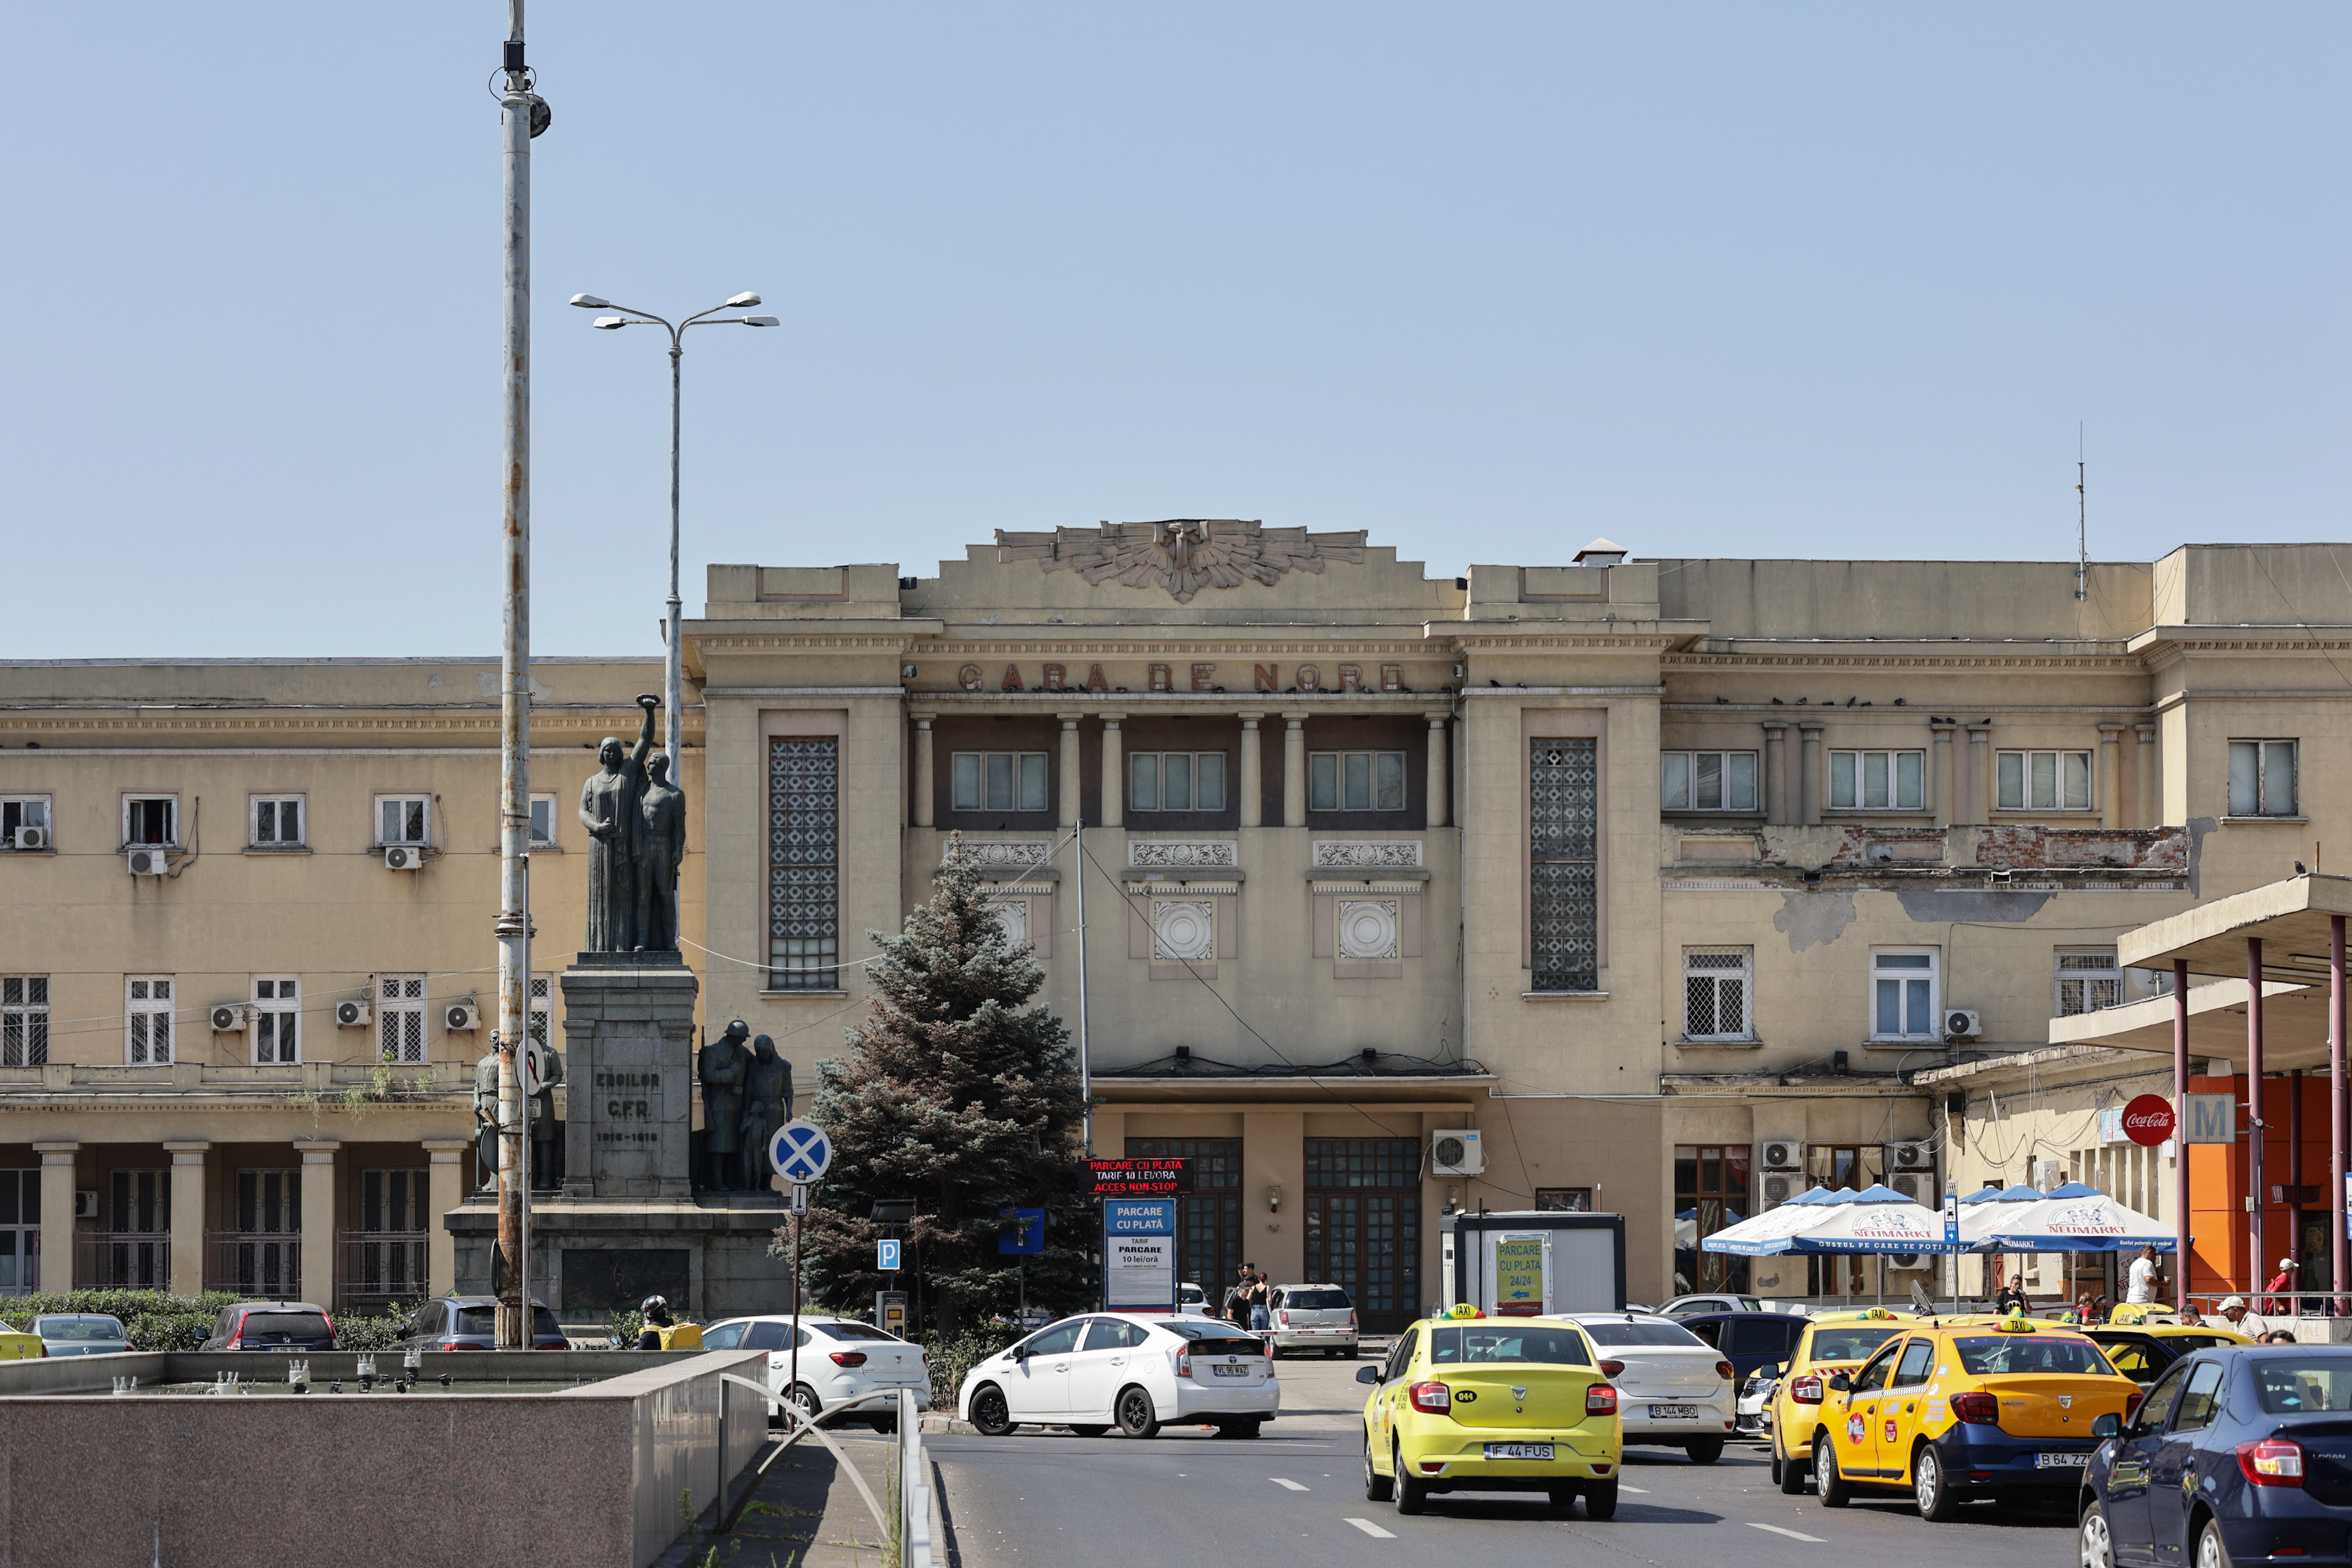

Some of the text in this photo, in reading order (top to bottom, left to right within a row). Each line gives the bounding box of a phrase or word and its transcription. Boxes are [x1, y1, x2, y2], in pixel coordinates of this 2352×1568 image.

[959, 664, 1405, 690] GARA DE NORD
[596, 1073, 659, 1087] EROILOR
[608, 1100, 651, 1117] C.F.R.
[2126, 1112, 2171, 1129] Coca-Cola
[2195, 1101, 2226, 1137] M
[1090, 1160, 1183, 1170] PARCARE CU PLATA
[1096, 1170, 1176, 1180] TARIF 10 LEI/ORA
[1094, 1182, 1177, 1192] ACCES NON-STOP
[1117, 1207, 1163, 1216] PARCARE
[1116, 1218, 1164, 1229] CU PLATĂ
[1946, 1222, 1956, 1231] TAXI
[2046, 1222, 2127, 1234] NEUMARKT
[1851, 1227, 1932, 1238] NEUMARKT
[2001, 1236, 2035, 1248] NEUMARKT
[1499, 1245, 1541, 1256] PARCARE
[1133, 1255, 1158, 1263] lei/oră
[1499, 1260, 1541, 1271] CU PLATA
[1510, 1276, 1532, 1286] 24/24
[1455, 1306, 1471, 1316] TAXI
[1871, 1309, 1885, 1319] TAXI
[2119, 1314, 2131, 1323] TAXI
[2010, 1320, 2026, 1331] TAXI
[1458, 1392, 1474, 1400] 044
[1654, 1406, 1696, 1415] B 144 MBO
[1492, 1446, 1550, 1457] IF 44 FUS
[2041, 1454, 2091, 1465] B 64 ZZ
